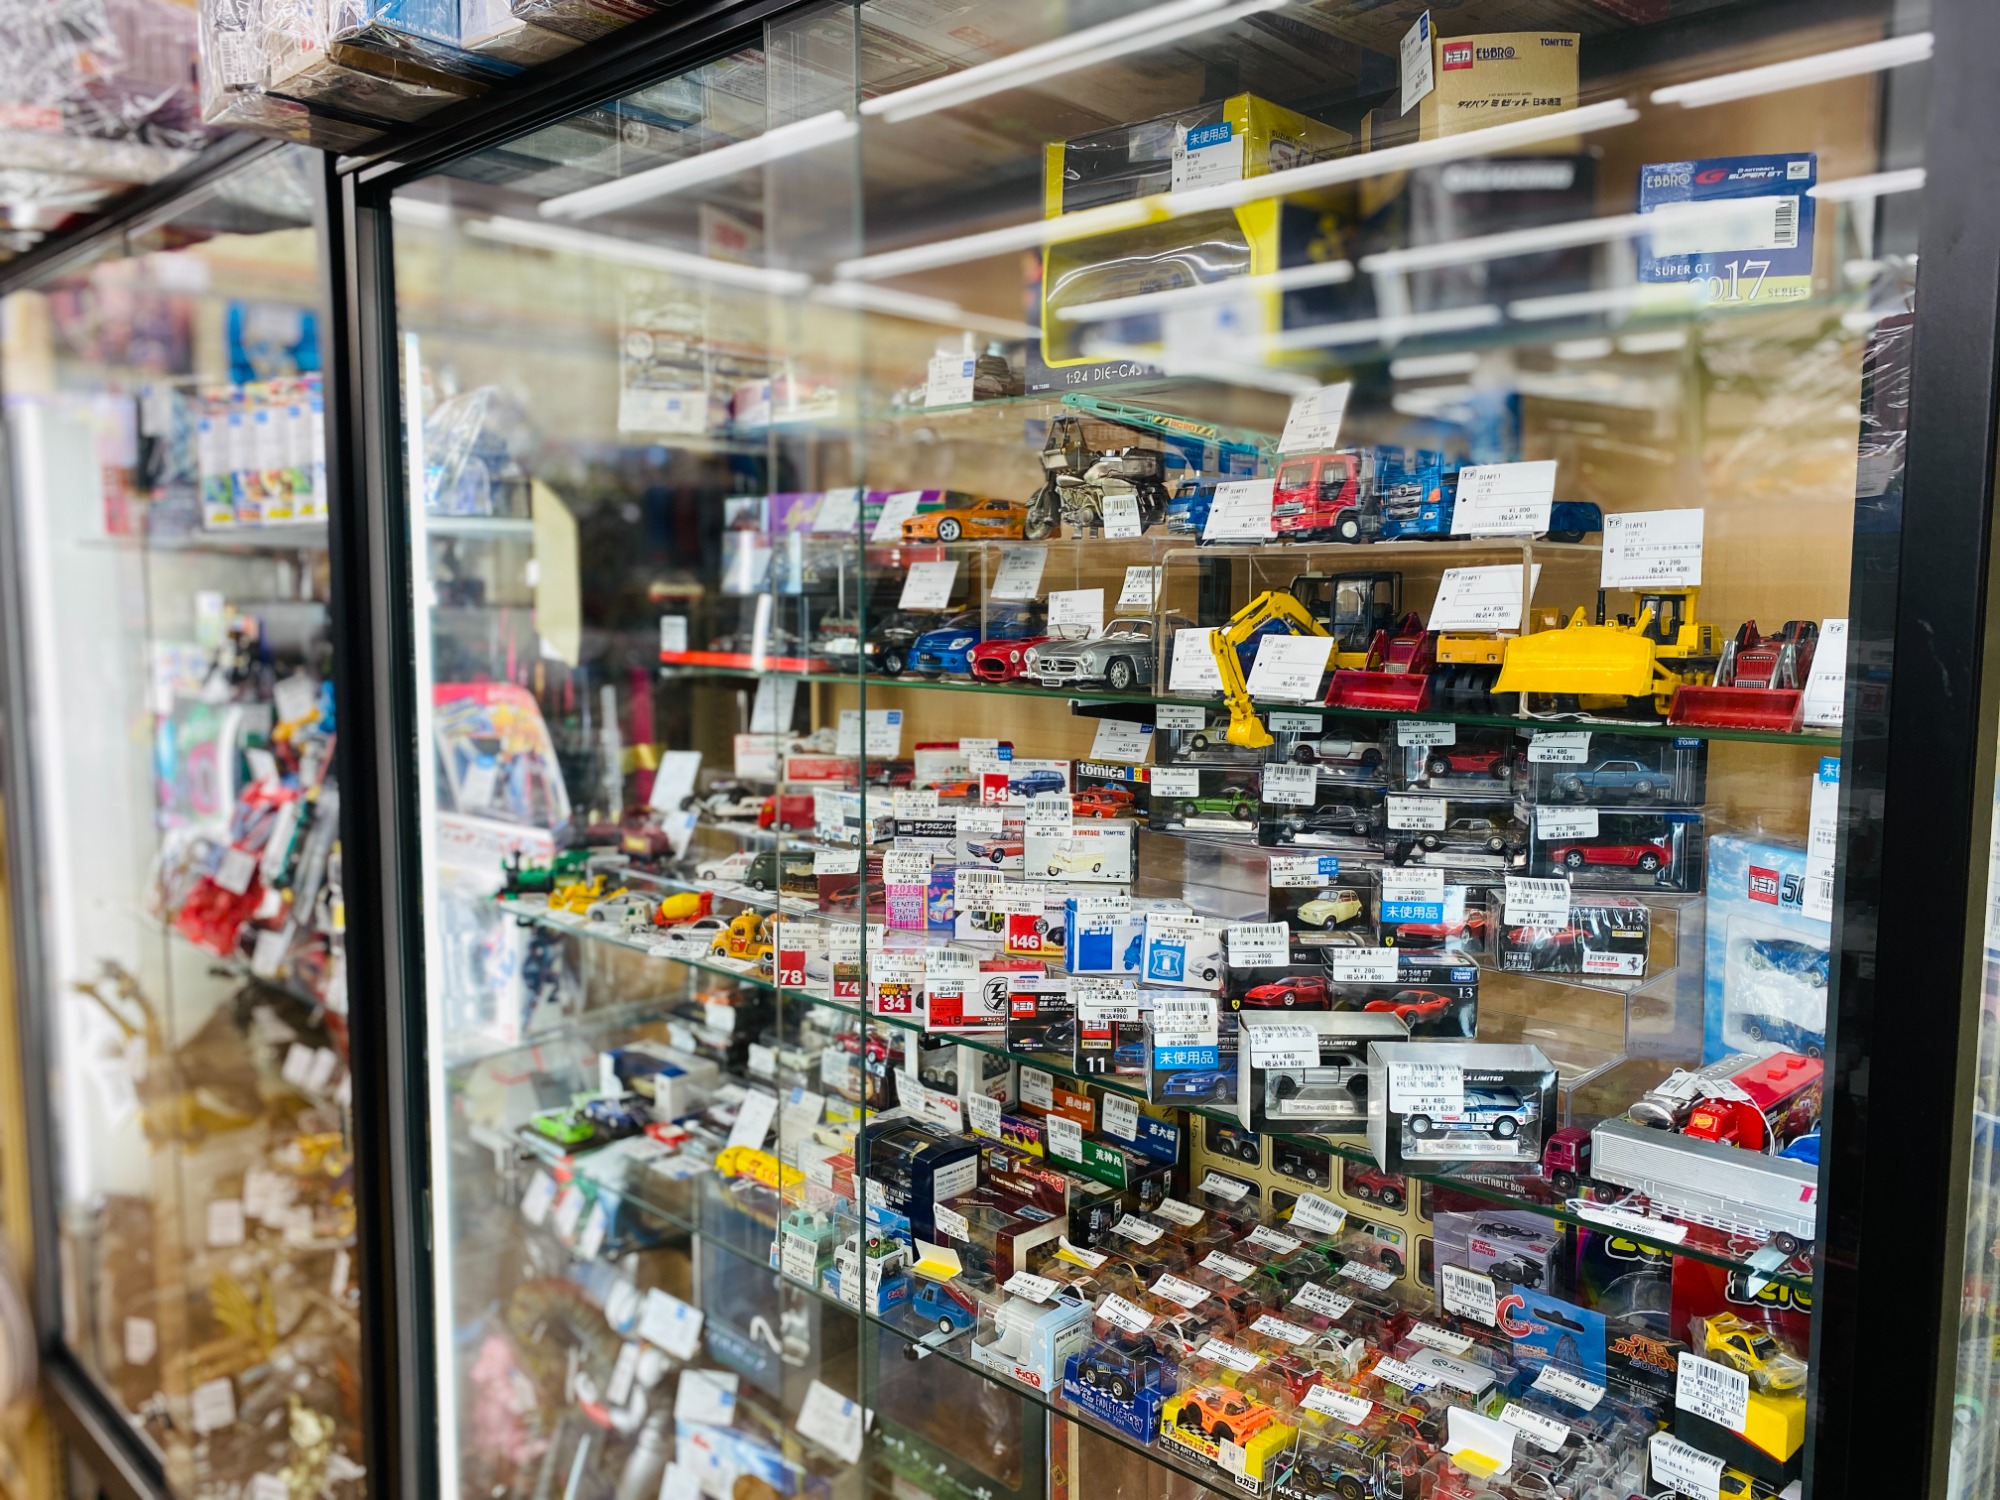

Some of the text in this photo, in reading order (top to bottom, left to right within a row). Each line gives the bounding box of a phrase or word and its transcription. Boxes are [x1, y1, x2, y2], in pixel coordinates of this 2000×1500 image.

[1540, 39, 1573, 47] TOMYTEC
[1189, 128, 1229, 146] 未使用品
[1647, 174, 1690, 188] EBBRO
[1728, 171, 1766, 179] SUPER
[1655, 263, 1710, 276] SUPER GT
[1768, 287, 1807, 297] SERIES
[1066, 370, 1087, 385] 1:24
[1218, 731, 1226, 740] 12
[1079, 764, 1125, 779] tomica
[1134, 770, 1142, 778] 27
[985, 787, 1008, 800] 54
[893, 885, 918, 894] 2018
[1750, 876, 1777, 895] トミカ
[1386, 906, 1438, 919] 未使用品
[1627, 911, 1644, 922] 13
[1010, 935, 1039, 948] 146
[780, 970, 803, 984] 78
[839, 981, 860, 995] 74
[1458, 987, 1473, 998] 13
[883, 996, 906, 1010] 34
[1012, 1002, 1034, 1011] トミカ
[947, 1015, 961, 1025] 18
[1086, 1057, 1105, 1072] 11
[1160, 1051, 1214, 1065] 未使用品
[1469, 1112, 1477, 1122] 11
[1462, 1174, 1526, 1194] COLLECTABLE BOX
[1056, 1331, 1071, 1343] WHITE
[1609, 1340, 1678, 1372] DRAGON
[1629, 1357, 1669, 1378] 2000
[1014, 1367, 1041, 1387] チョロQ
[1095, 1395, 1119, 1415] ENDLESS
[1179, 1442, 1196, 1458] ARTA
[1236, 1475, 1257, 1490] タカラ
[1277, 1485, 1302, 1499] HKS
